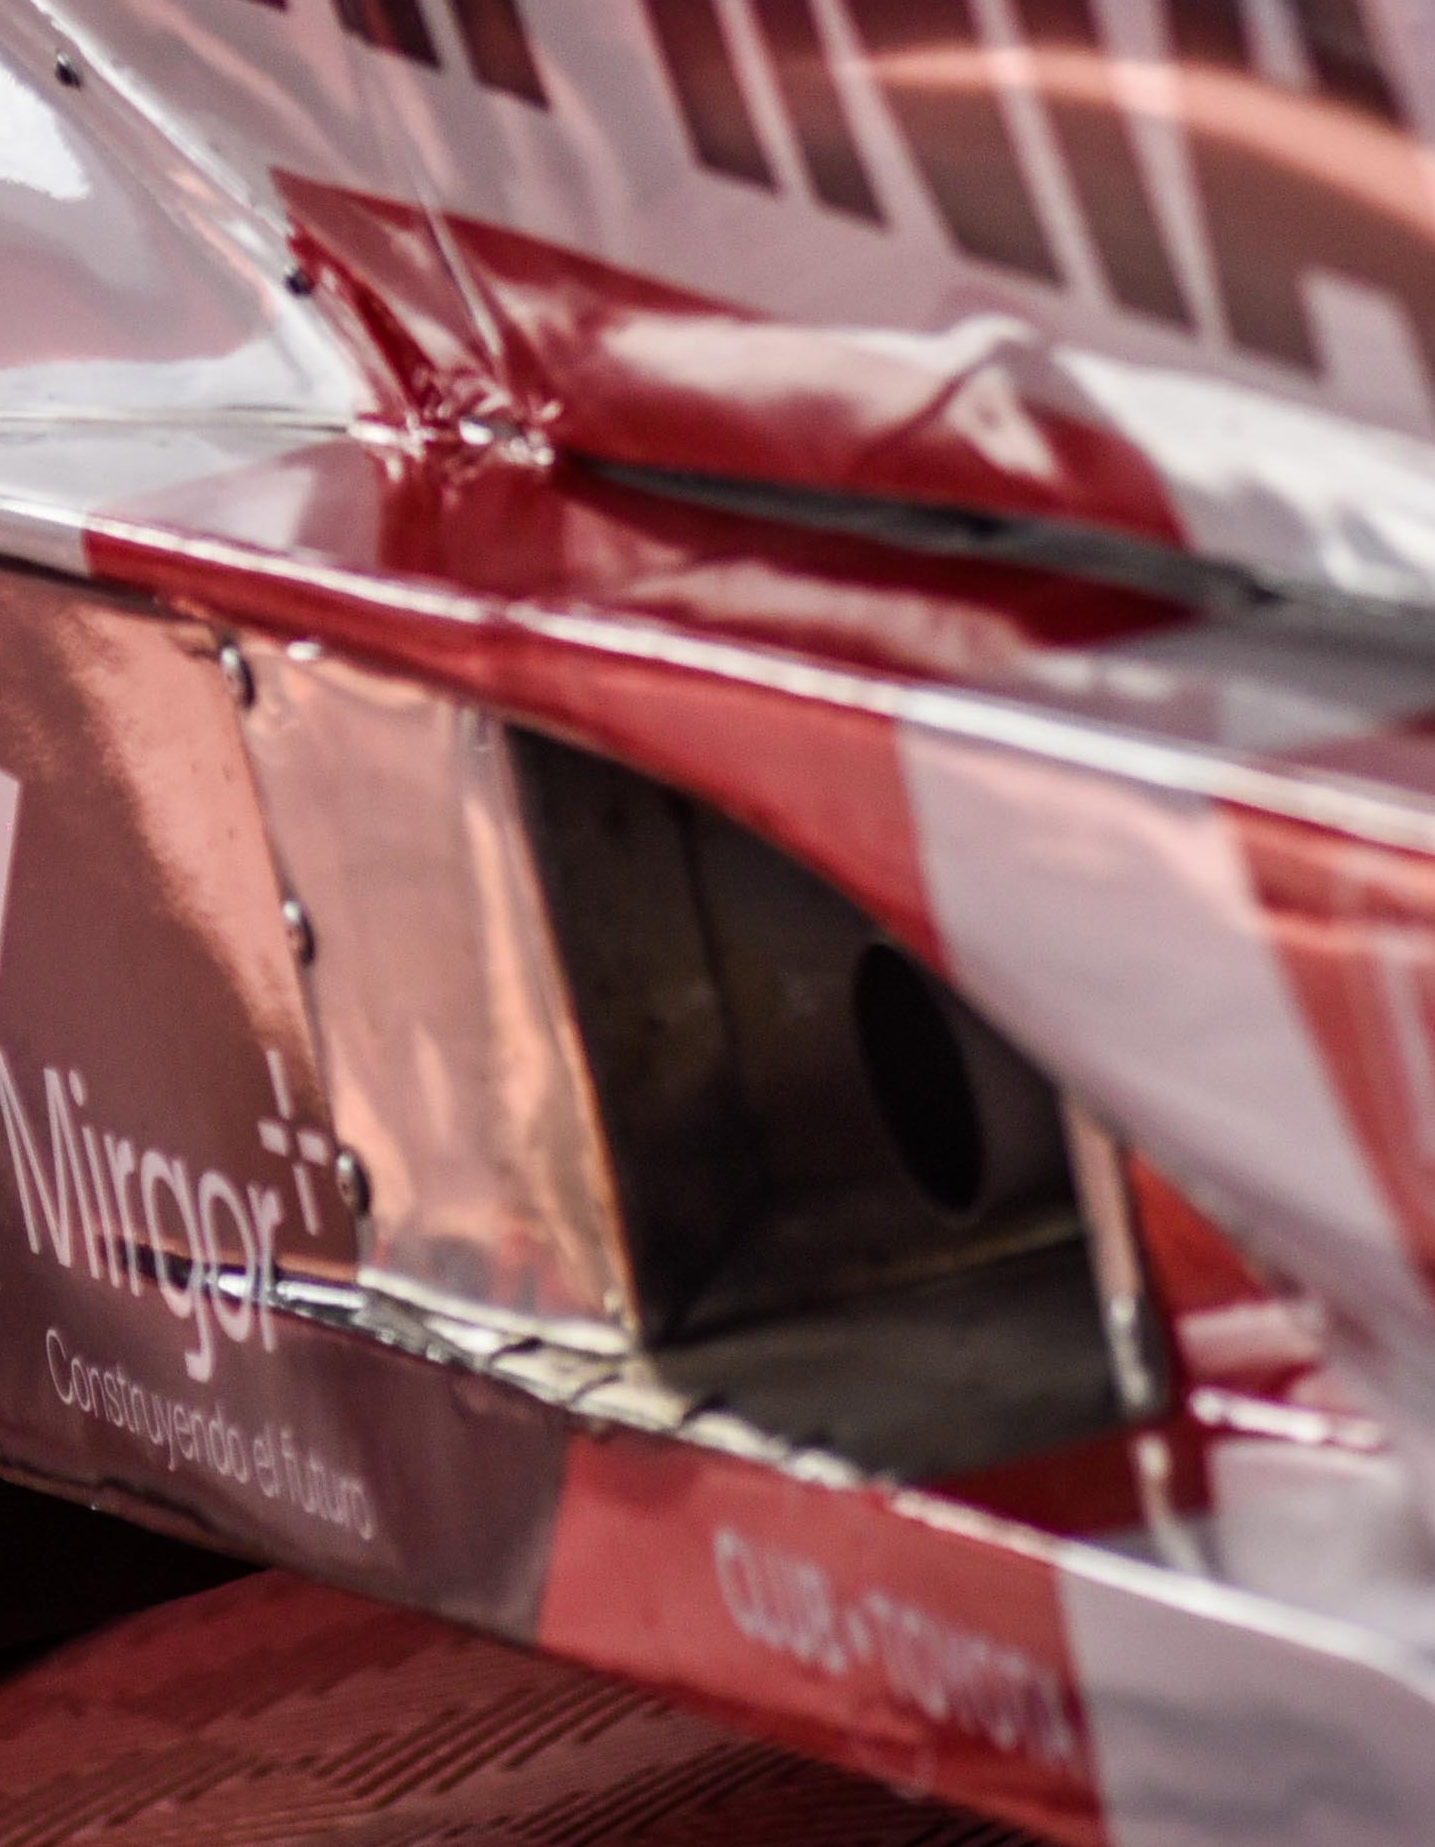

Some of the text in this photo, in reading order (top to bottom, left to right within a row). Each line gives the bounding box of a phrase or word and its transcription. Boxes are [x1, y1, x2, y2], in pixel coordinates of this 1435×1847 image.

[45, 1327, 251, 1486] Construyendo
[712, 1520, 1081, 1770] CLUB TOYOTA
